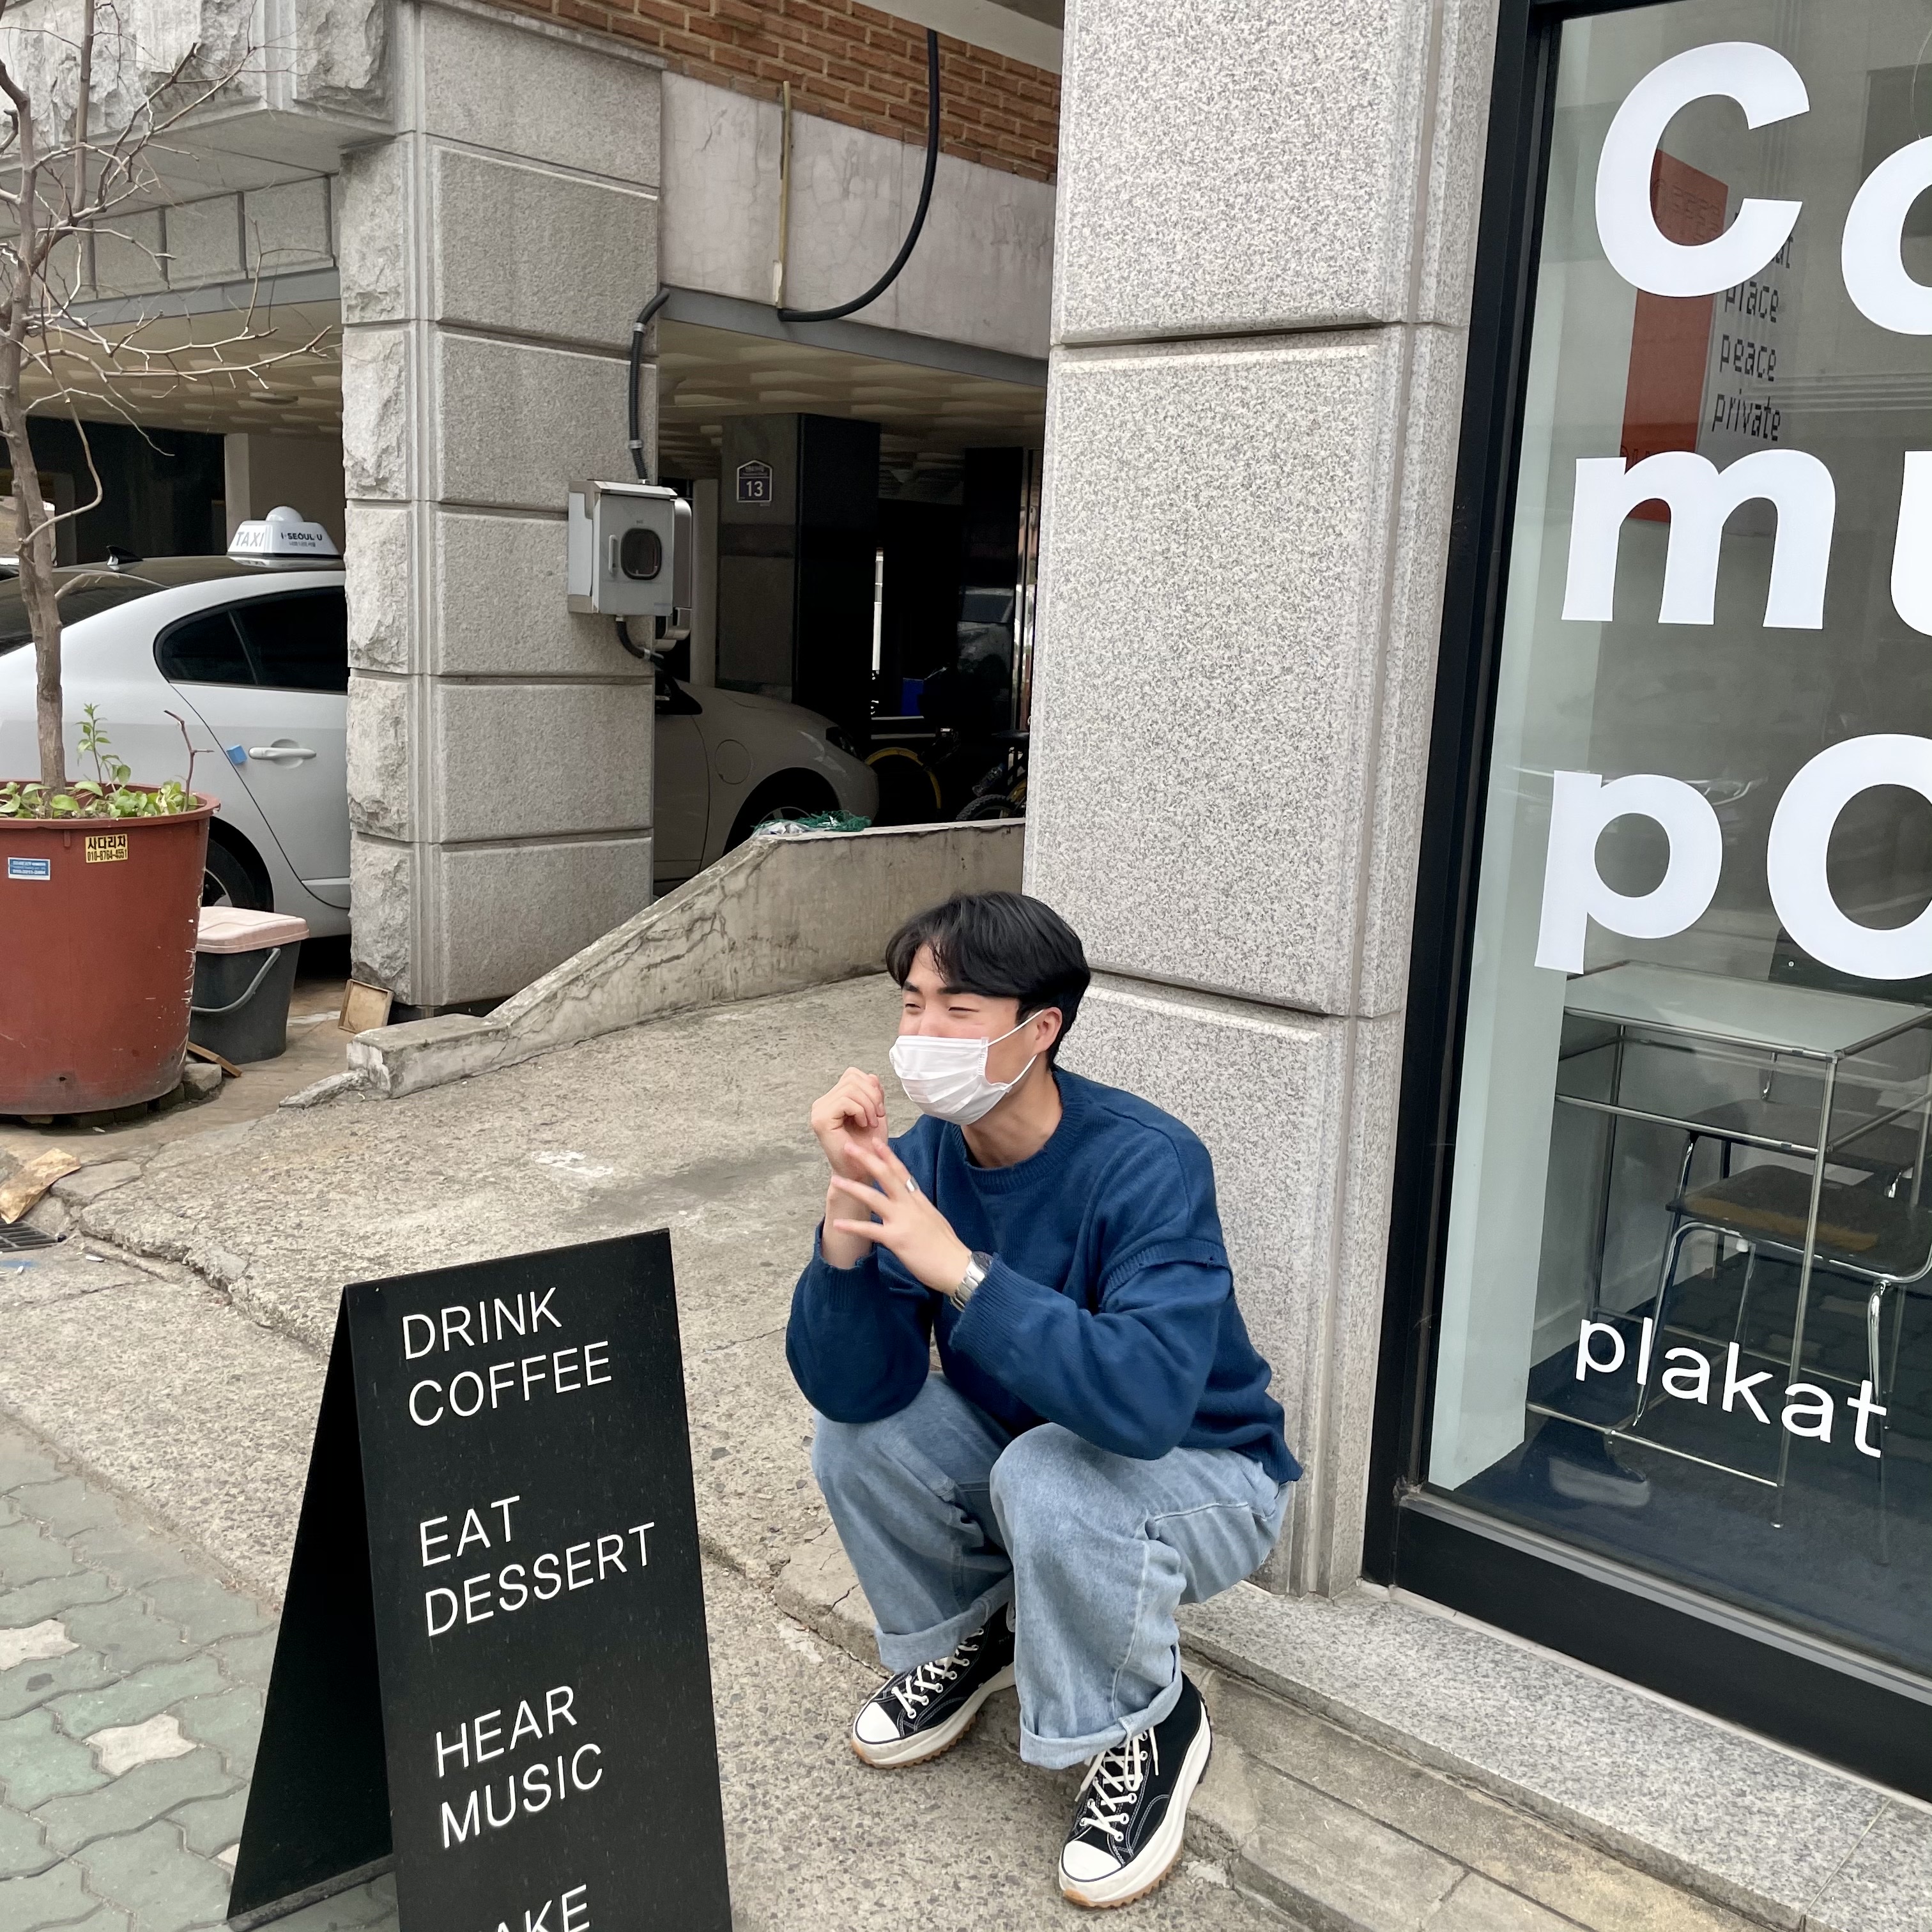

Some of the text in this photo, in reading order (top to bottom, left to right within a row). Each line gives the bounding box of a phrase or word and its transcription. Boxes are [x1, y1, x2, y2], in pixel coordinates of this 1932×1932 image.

[1719, 334, 1777, 381] peace
[1712, 388, 1781, 441] private
[746, 480, 763, 497] 13
[236, 531, 265, 548] TAXI
[1561, 450, 1932, 636] m
[88, 834, 126, 850] 사다리차
[402, 1287, 562, 1360] DRINK
[409, 1340, 612, 1427] COFFEE
[1576, 1317, 1887, 1458] plakat
[420, 1496, 520, 1567] EAT
[425, 1521, 655, 1637] DESSERT
[436, 1685, 578, 1778] HEAR
[441, 1743, 603, 1848] MUSIC
